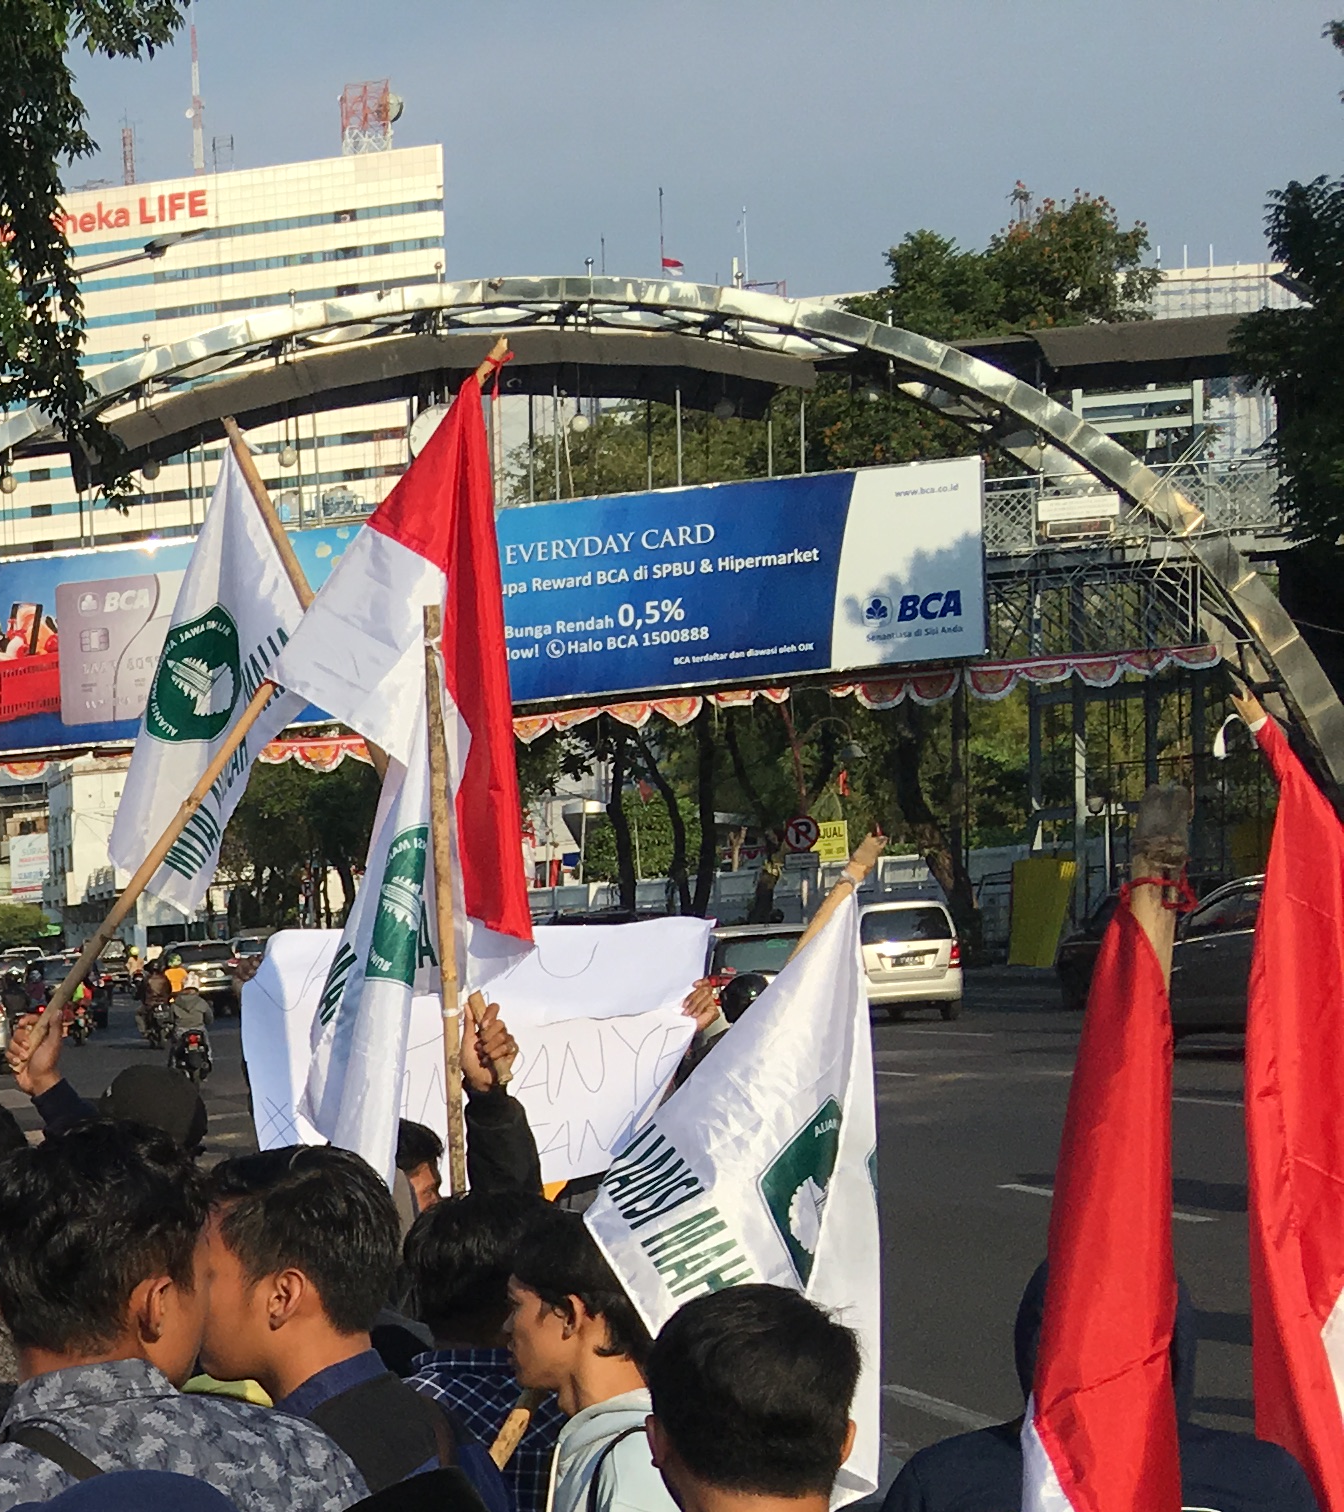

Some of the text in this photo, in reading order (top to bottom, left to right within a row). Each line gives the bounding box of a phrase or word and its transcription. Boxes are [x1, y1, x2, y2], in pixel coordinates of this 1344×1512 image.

[138, 189, 208, 224] LIFE
[894, 483, 960, 498] www.bca.co.id
[504, 523, 715, 566] EVERYDAY CARD
[531, 571, 592, 593] Reward
[596, 569, 630, 585] BCA
[633, 564, 649, 581] di
[652, 560, 696, 580] SPBU
[699, 558, 714, 574] &
[717, 547, 820, 573] Hipermarket
[102, 588, 150, 613] BCA
[897, 589, 962, 623] BCA
[504, 598, 685, 640] Bunga Rendah 0,5%
[866, 624, 964, 643] Senantiasa di Sisi Anda
[567, 638, 603, 655] Halo
[606, 635, 639, 651] BCA
[642, 625, 710, 647] 1500888
[673, 656, 691, 666] BCA
[692, 652, 729, 664] terdaftar
[729, 650, 746, 660] dan
[746, 645, 778, 658] diawasi
